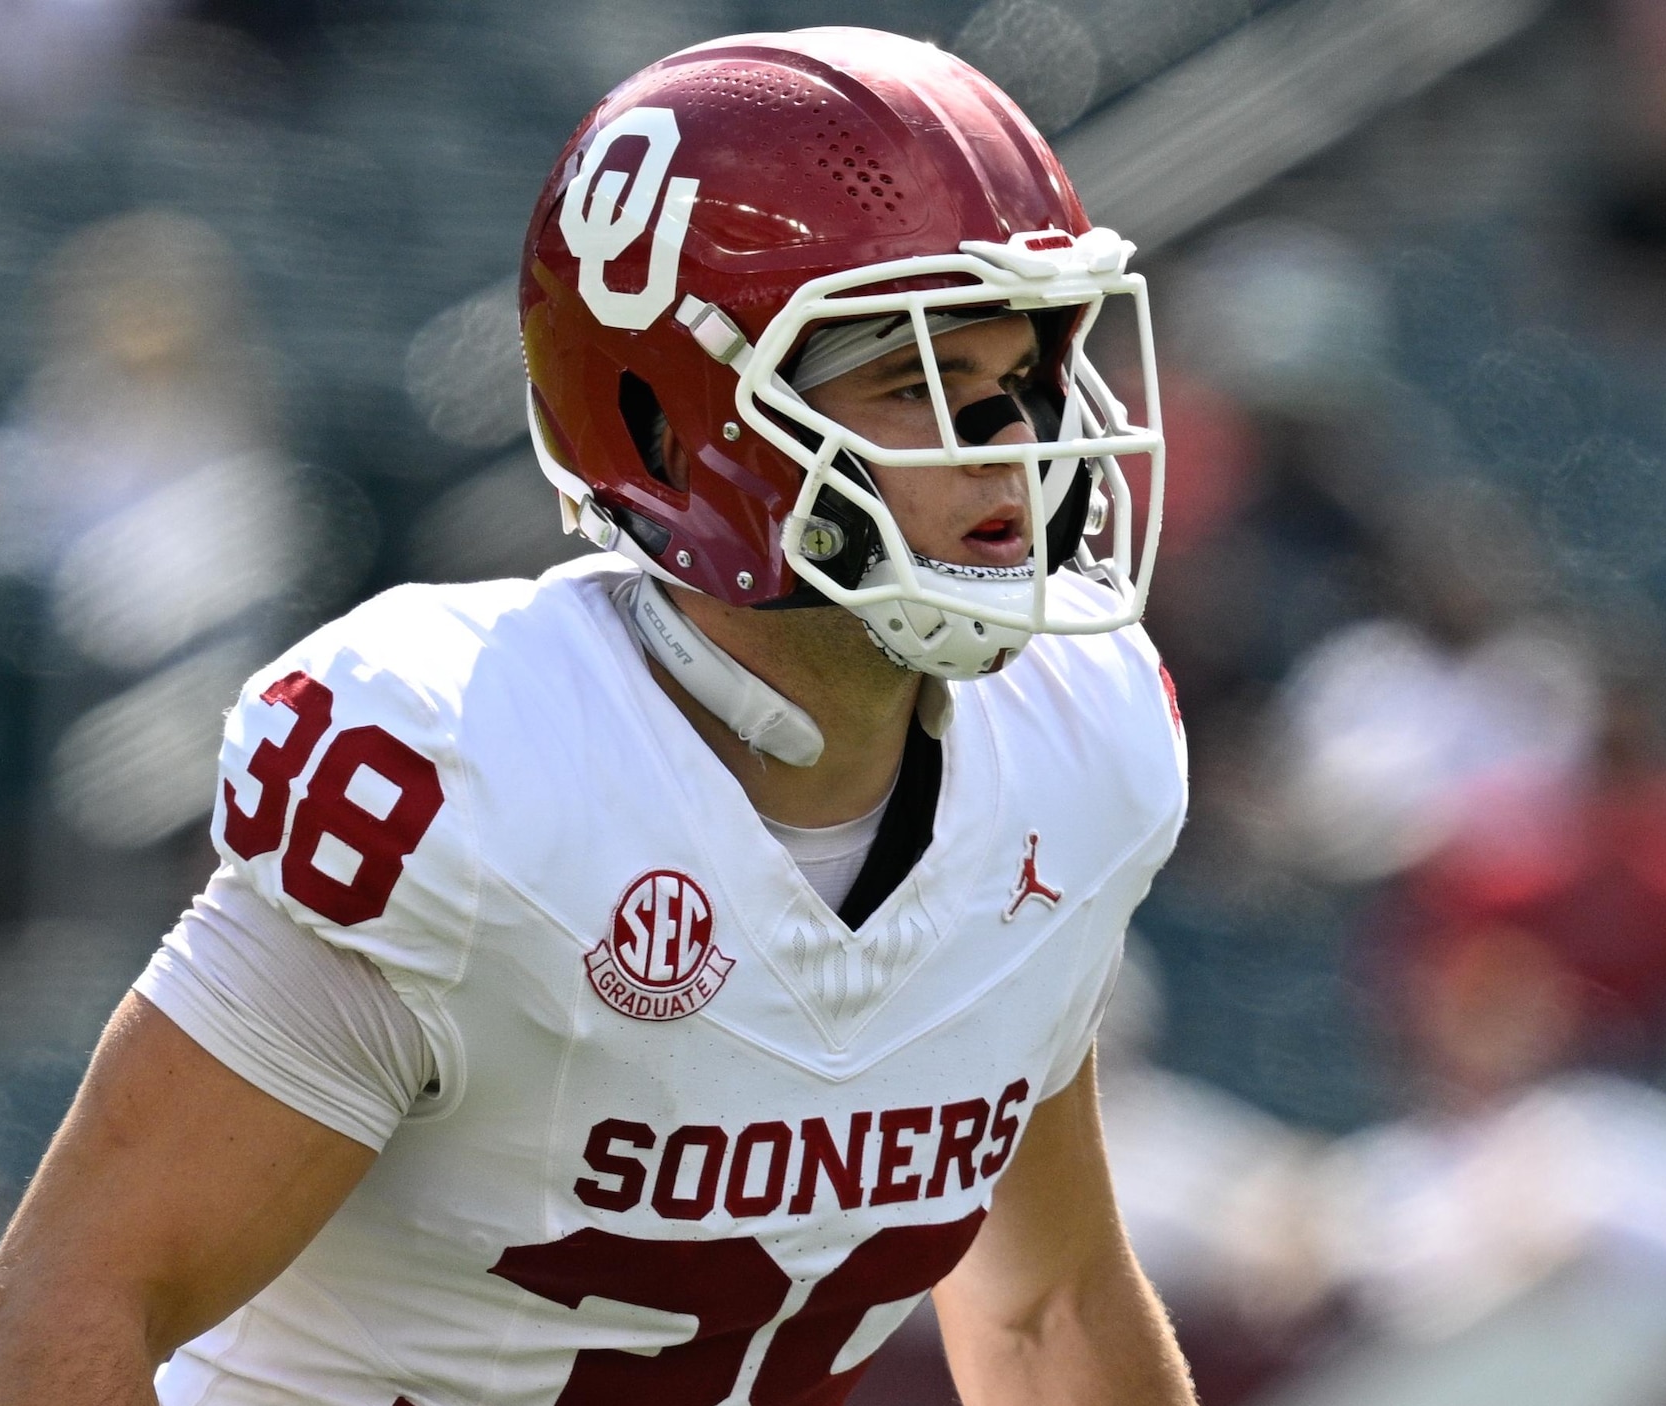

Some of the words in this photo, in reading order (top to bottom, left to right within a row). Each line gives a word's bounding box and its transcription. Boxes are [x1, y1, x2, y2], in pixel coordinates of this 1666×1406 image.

[559, 106, 700, 331] OU
[224, 670, 445, 927] 38
[598, 970, 712, 1018] GRADUATE
[619, 875, 708, 981] SEC
[573, 1077, 1030, 1221] SOONERS
